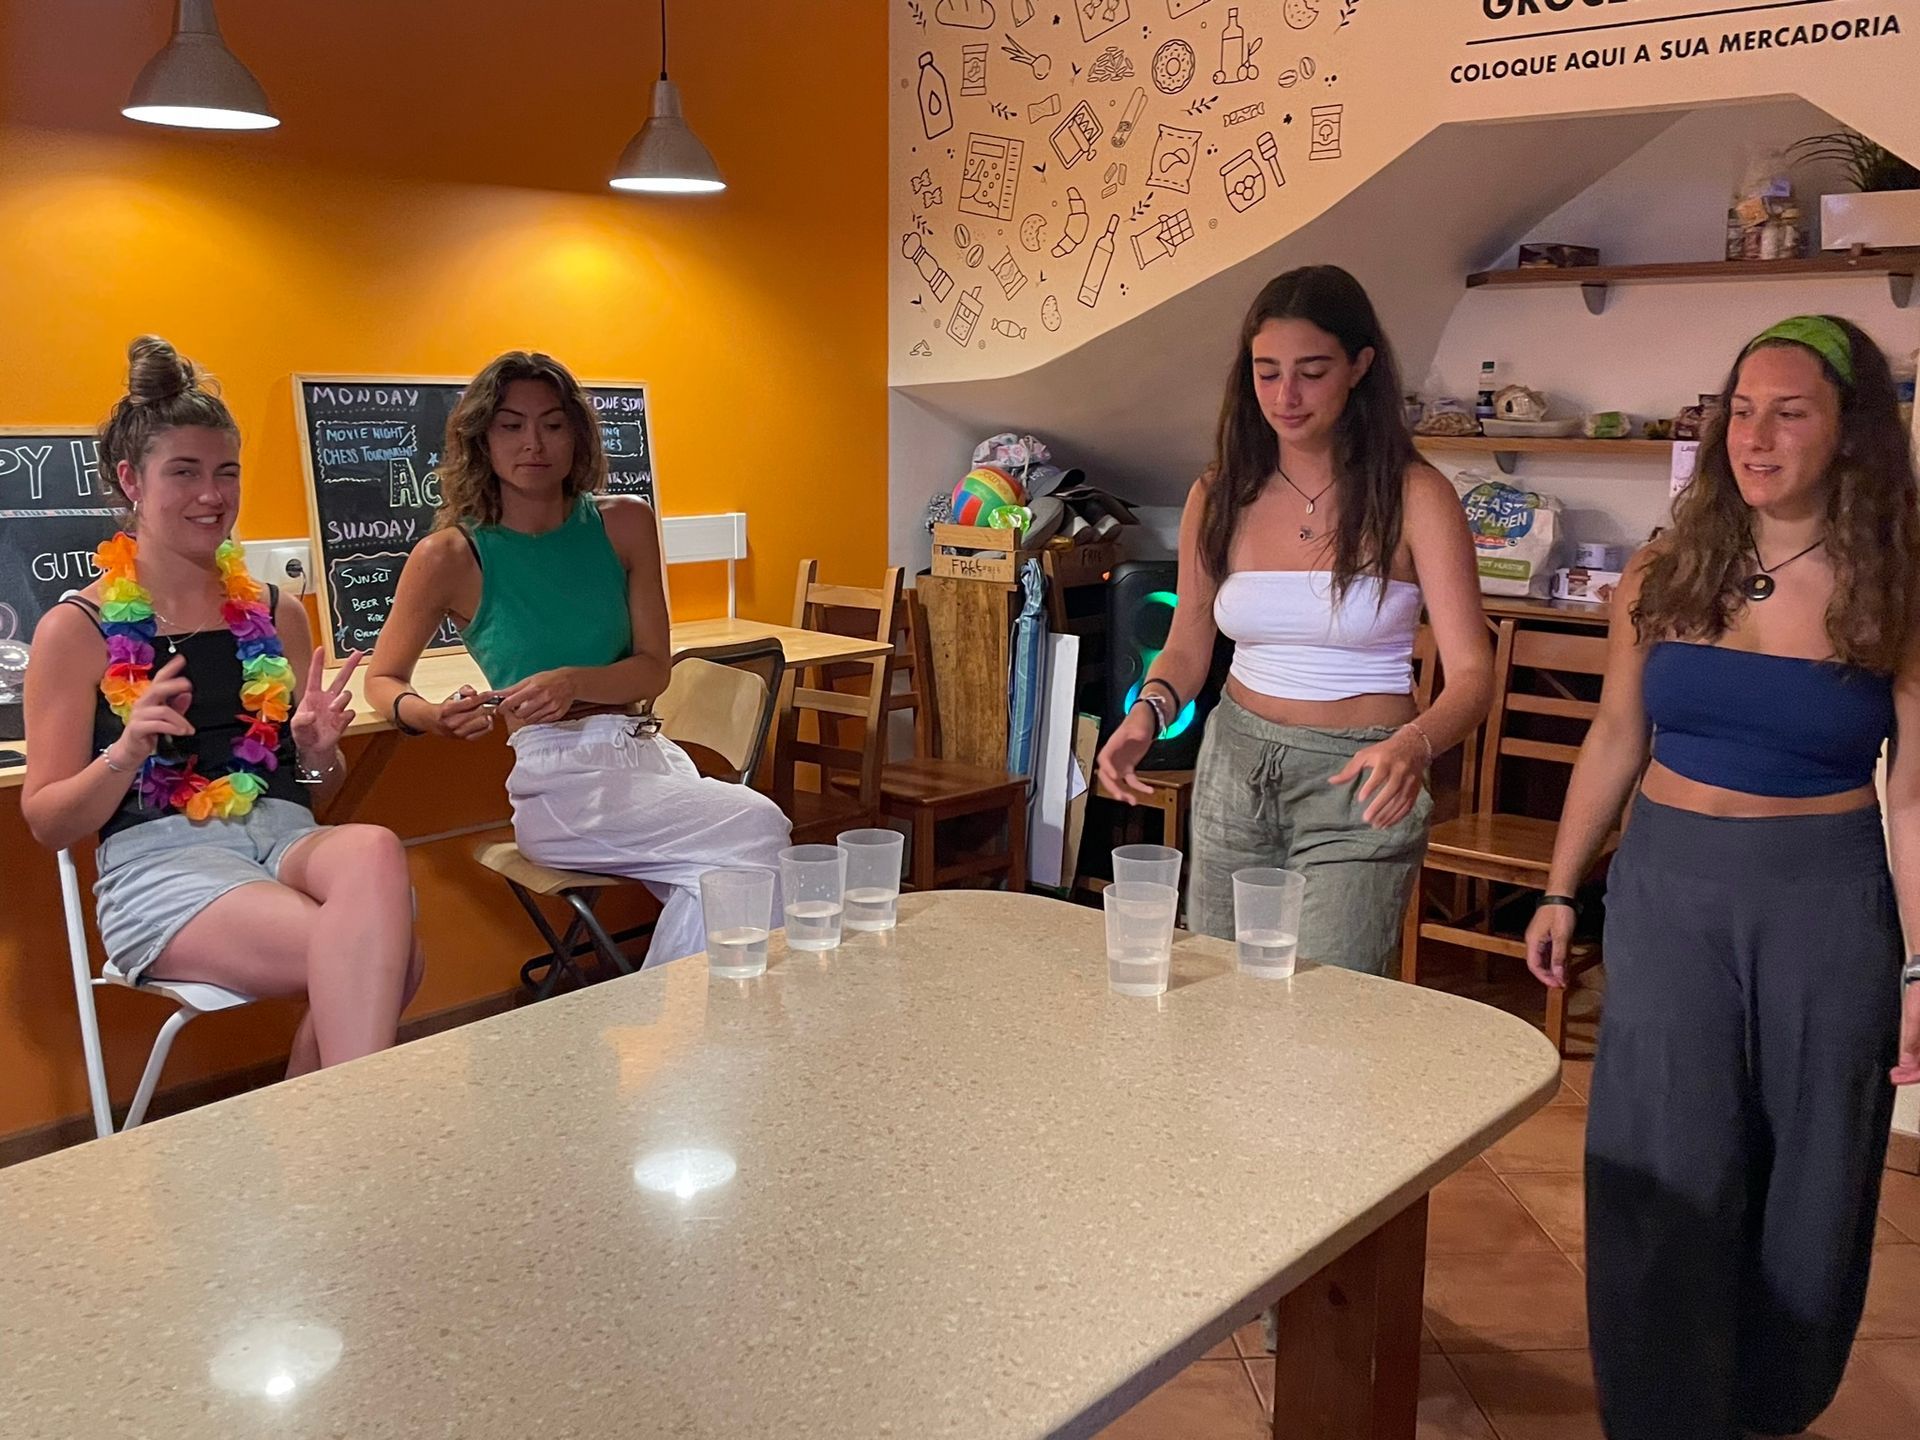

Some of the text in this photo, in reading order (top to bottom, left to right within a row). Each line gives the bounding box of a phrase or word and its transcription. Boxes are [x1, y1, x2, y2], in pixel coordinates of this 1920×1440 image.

[1450, 15, 1901, 83] COLOQUE AQUI A SUA MERCADORIA
[313, 386, 419, 406] MONDAY
[326, 428, 368, 441] MOVIE
[372, 426, 405, 439] NIGHT
[602, 427, 620, 437] ING
[602, 440, 622, 451] MES
[323, 448, 360, 465] CHESS
[70, 440, 113, 496] H
[1465, 506, 1528, 528] SPAREN
[328, 519, 416, 542] SUNDAY
[32, 551, 104, 581] GUTE
[341, 568, 392, 588] SUNSET
[352, 598, 379, 611] BEER
